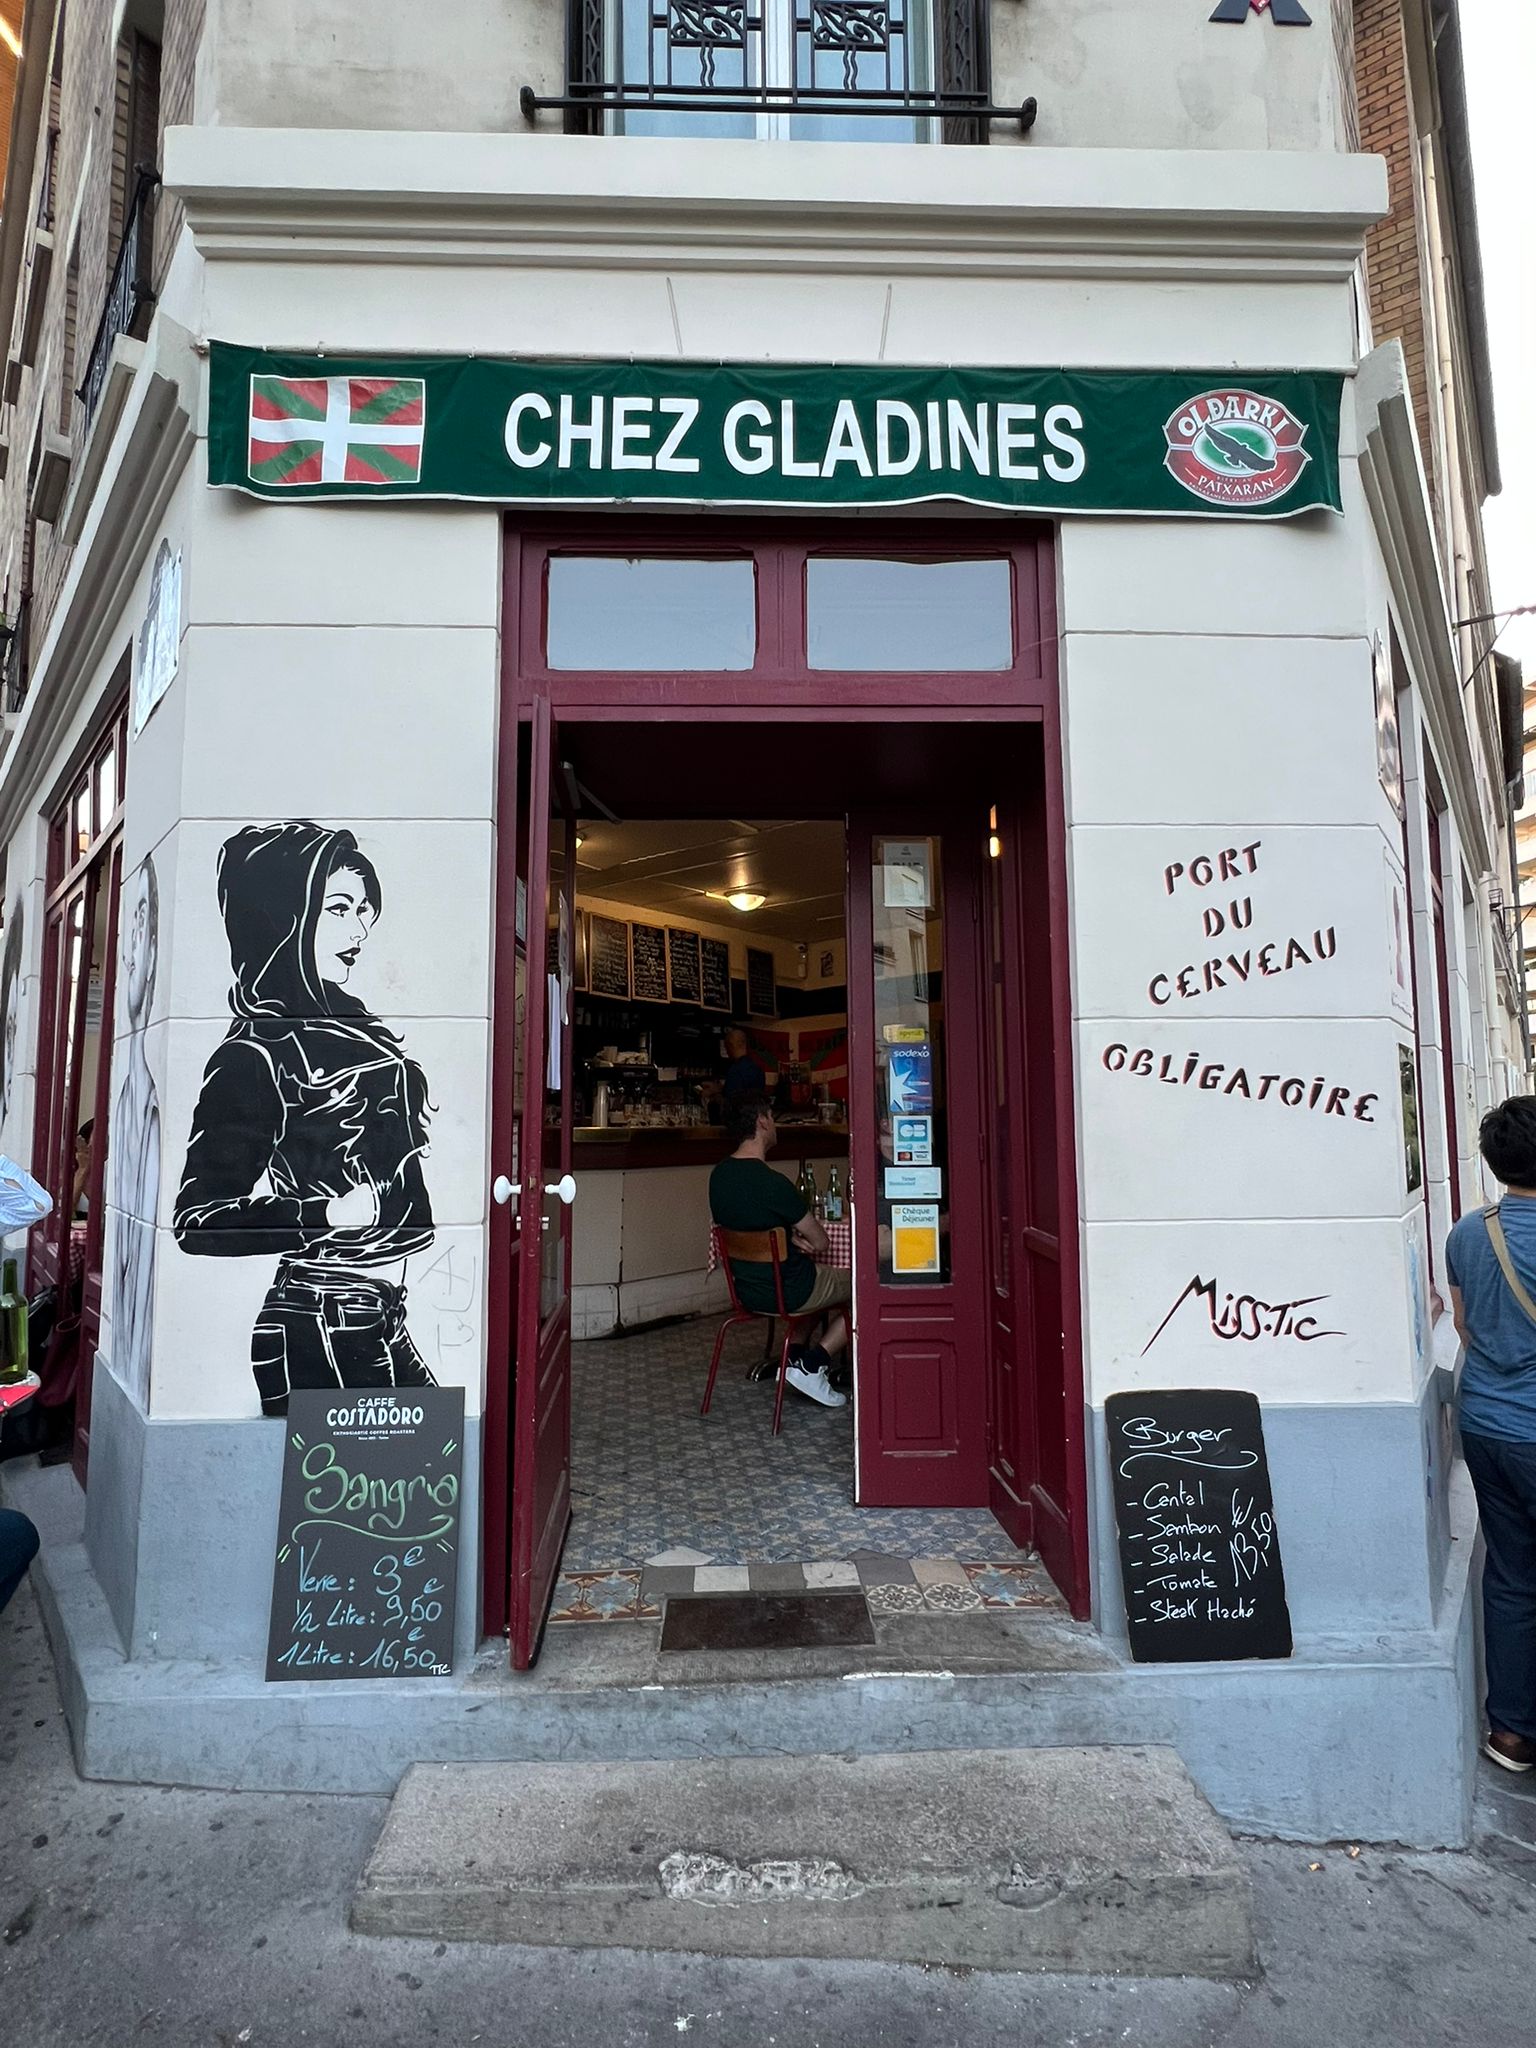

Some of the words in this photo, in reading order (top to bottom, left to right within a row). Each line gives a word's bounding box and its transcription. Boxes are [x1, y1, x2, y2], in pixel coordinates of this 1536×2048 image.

[1178, 396, 1289, 437] OLDARKI
[504, 392, 700, 472] CHEZ
[723, 398, 1086, 483] GLADINES
[1197, 474, 1274, 496] PATXARAN
[1163, 841, 1262, 896] PORT
[1202, 897, 1253, 937] DU
[1148, 926, 1336, 1006] CERVEAU
[893, 1046, 930, 1057] sodexo
[902, 1207, 930, 1215] Chèque
[903, 1215, 935, 1223] Déjeuner
[357, 1397, 396, 1408] CAFFE
[326, 1406, 424, 1426] COSTADORO
[1122, 1417, 1232, 1454] Burger
[302, 1442, 458, 1529] Sangria
[1143, 1480, 1204, 1510] Cantal
[1150, 1541, 1217, 1566] Salade
[1147, 1569, 1217, 1591] Tomate
[1149, 1598, 1198, 1622] Steak
[1207, 1597, 1256, 1622] Haché
[428, 1663, 452, 1675] TTC
